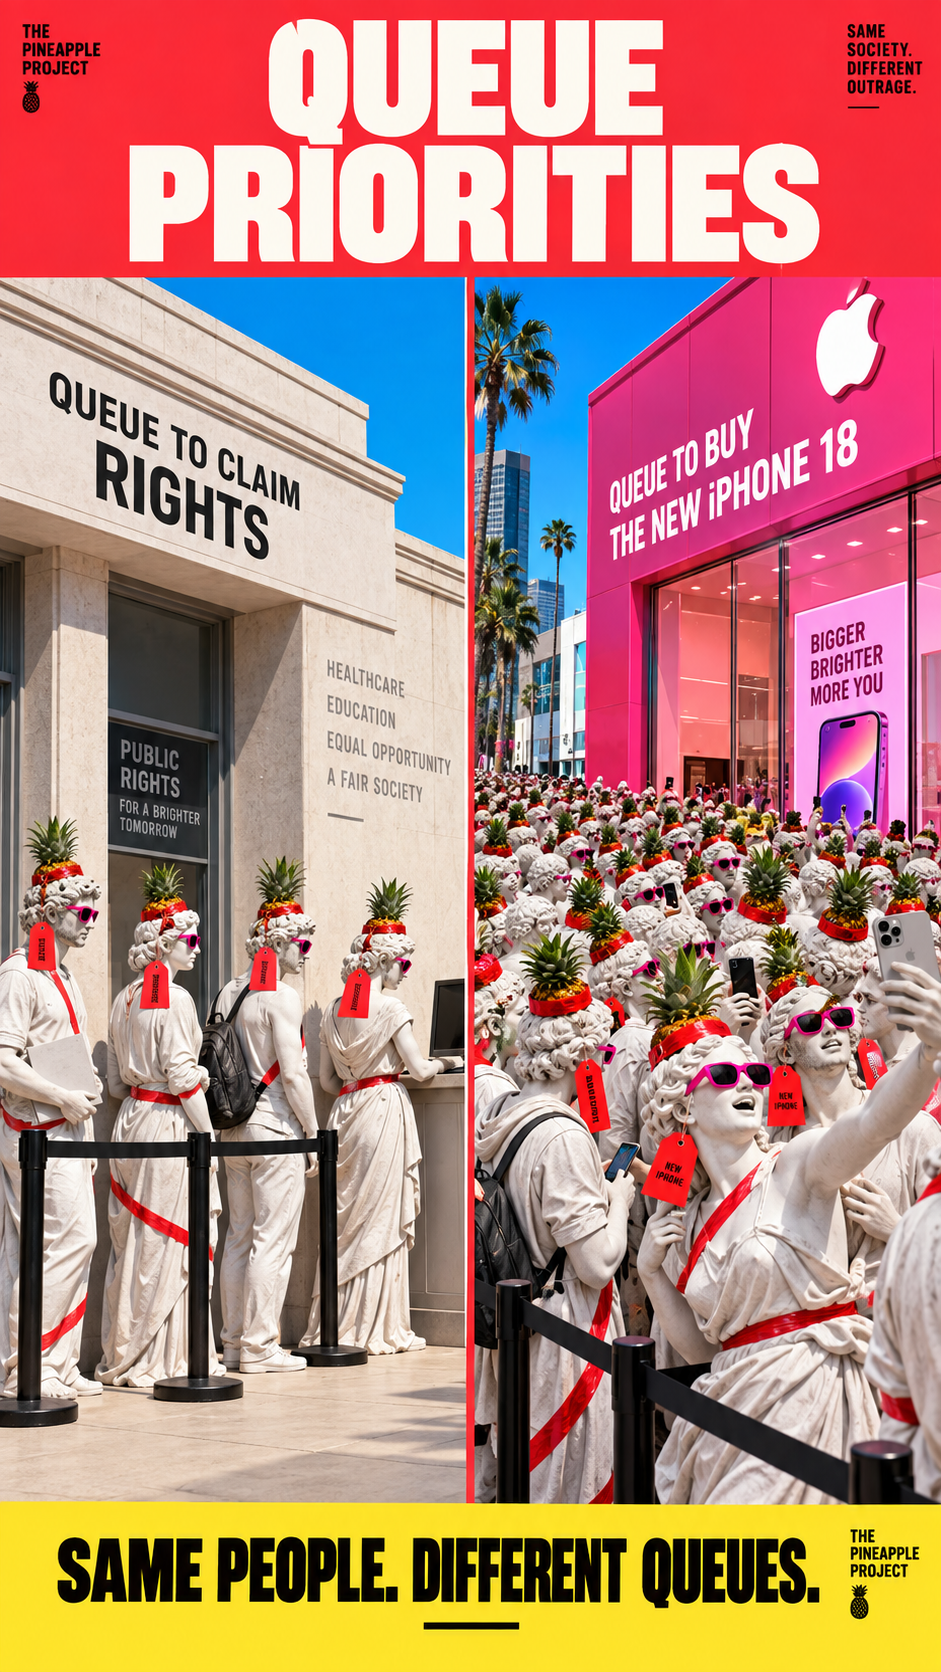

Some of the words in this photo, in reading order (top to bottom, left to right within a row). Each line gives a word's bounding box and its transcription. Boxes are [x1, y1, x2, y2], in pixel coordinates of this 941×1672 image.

[49, 371, 159, 451] QUEUE
[170, 424, 208, 469] TO
[218, 448, 301, 512] CLAIM
[609, 455, 668, 514] QUEUE
[672, 440, 699, 482] TO
[705, 408, 755, 468] BUY
[96, 439, 270, 560] RIGHTS
[609, 514, 646, 561] THE
[651, 488, 702, 545] NEW
[708, 438, 811, 521] iPHONE
[819, 419, 859, 474] 18
[811, 621, 866, 655] BIGGER
[327, 659, 405, 699] HEALTHCARE
[811, 644, 884, 681] BRIGHTER
[810, 679, 850, 707] MORE
[853, 671, 883, 698] YOU
[327, 694, 396, 730] EDUCATION
[121, 738, 180, 771] PUBLIC
[327, 730, 368, 758] EQUAL
[372, 741, 452, 776] OPPORTUNITY
[121, 766, 181, 798] RIGHTS
[327, 767, 336, 787] A
[341, 769, 369, 793] FAIR
[373, 776, 423, 803] SOCIETY
[119, 798, 140, 815] FOR
[142, 802, 150, 817] A
[153, 804, 201, 826] BRIGHTER
[119, 816, 178, 839] TOMORROW
[664, 1161, 683, 1175] NEW
